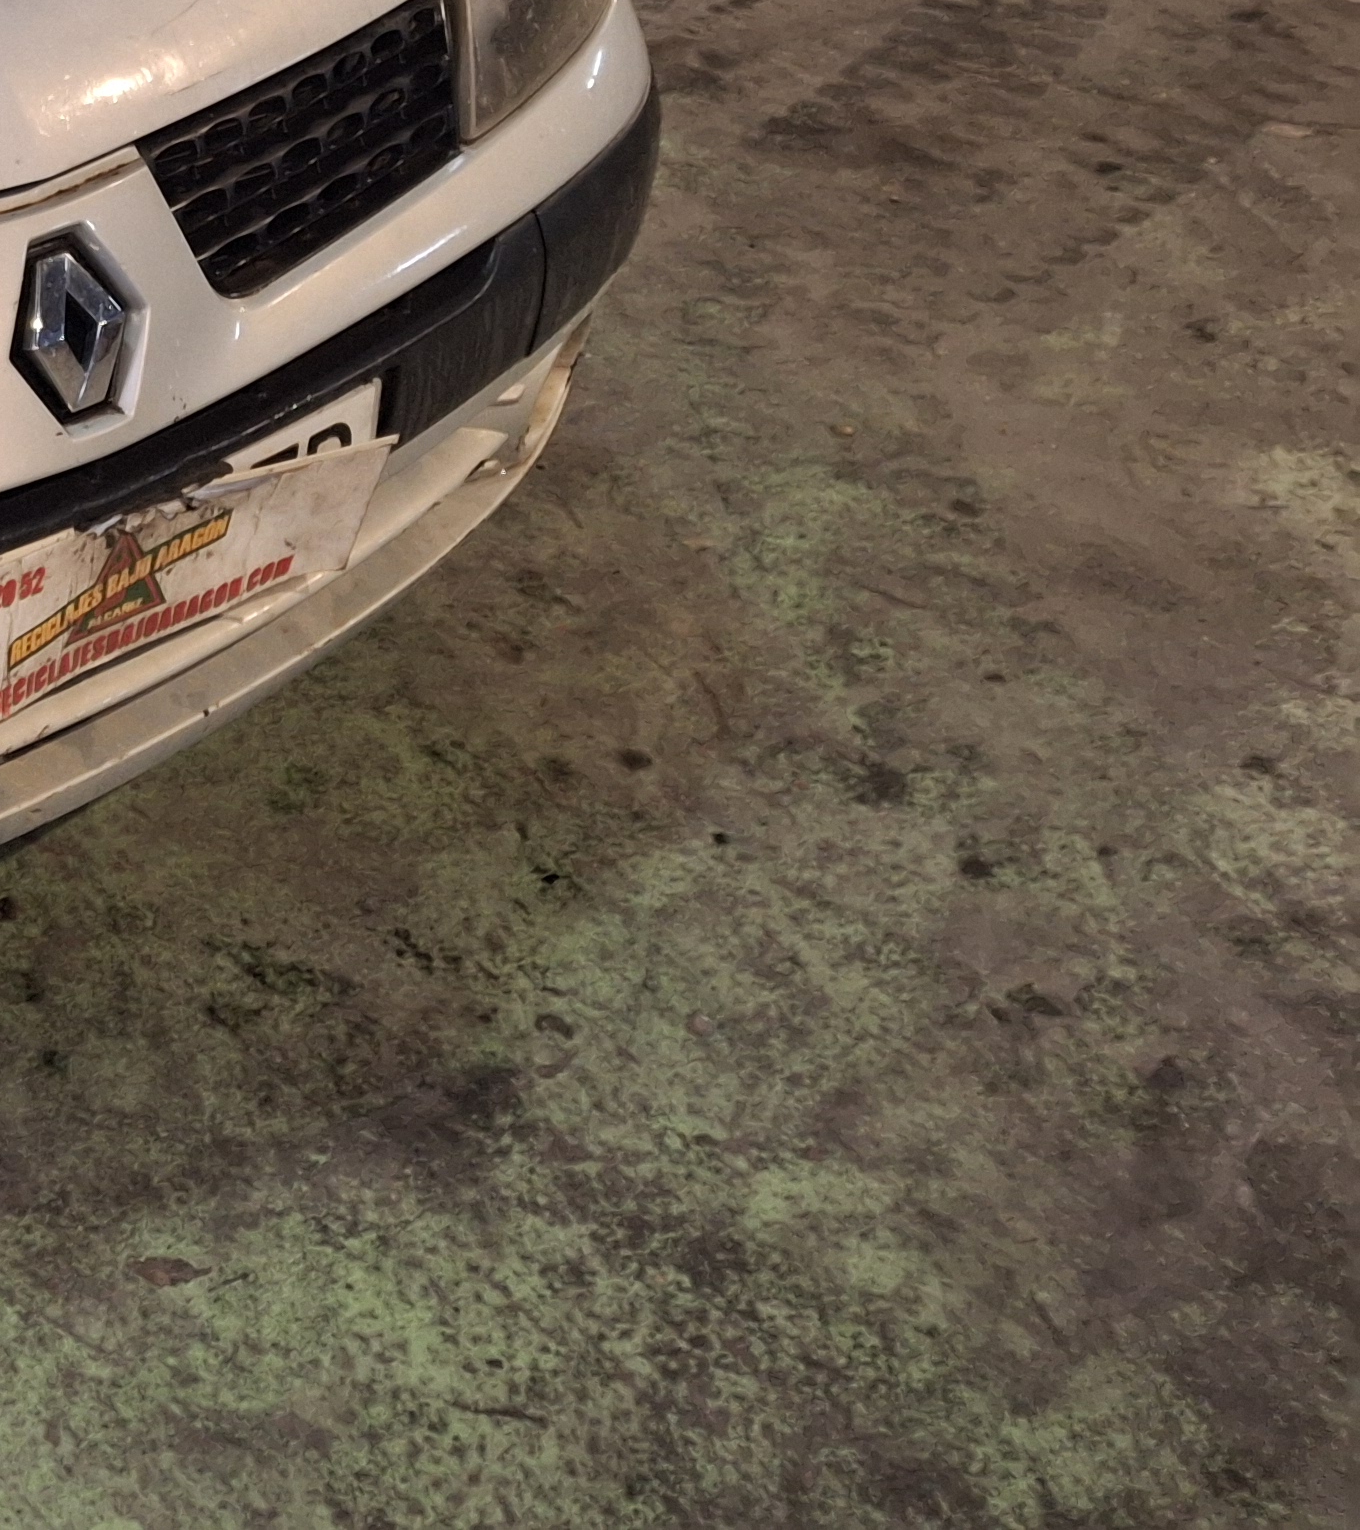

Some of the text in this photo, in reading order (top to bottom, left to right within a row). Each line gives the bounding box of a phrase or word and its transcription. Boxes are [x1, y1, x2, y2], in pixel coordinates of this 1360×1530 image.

[9, 582, 104, 667] RECICLAJES
[107, 553, 153, 597] BAJO
[19, 566, 47, 601] 52
